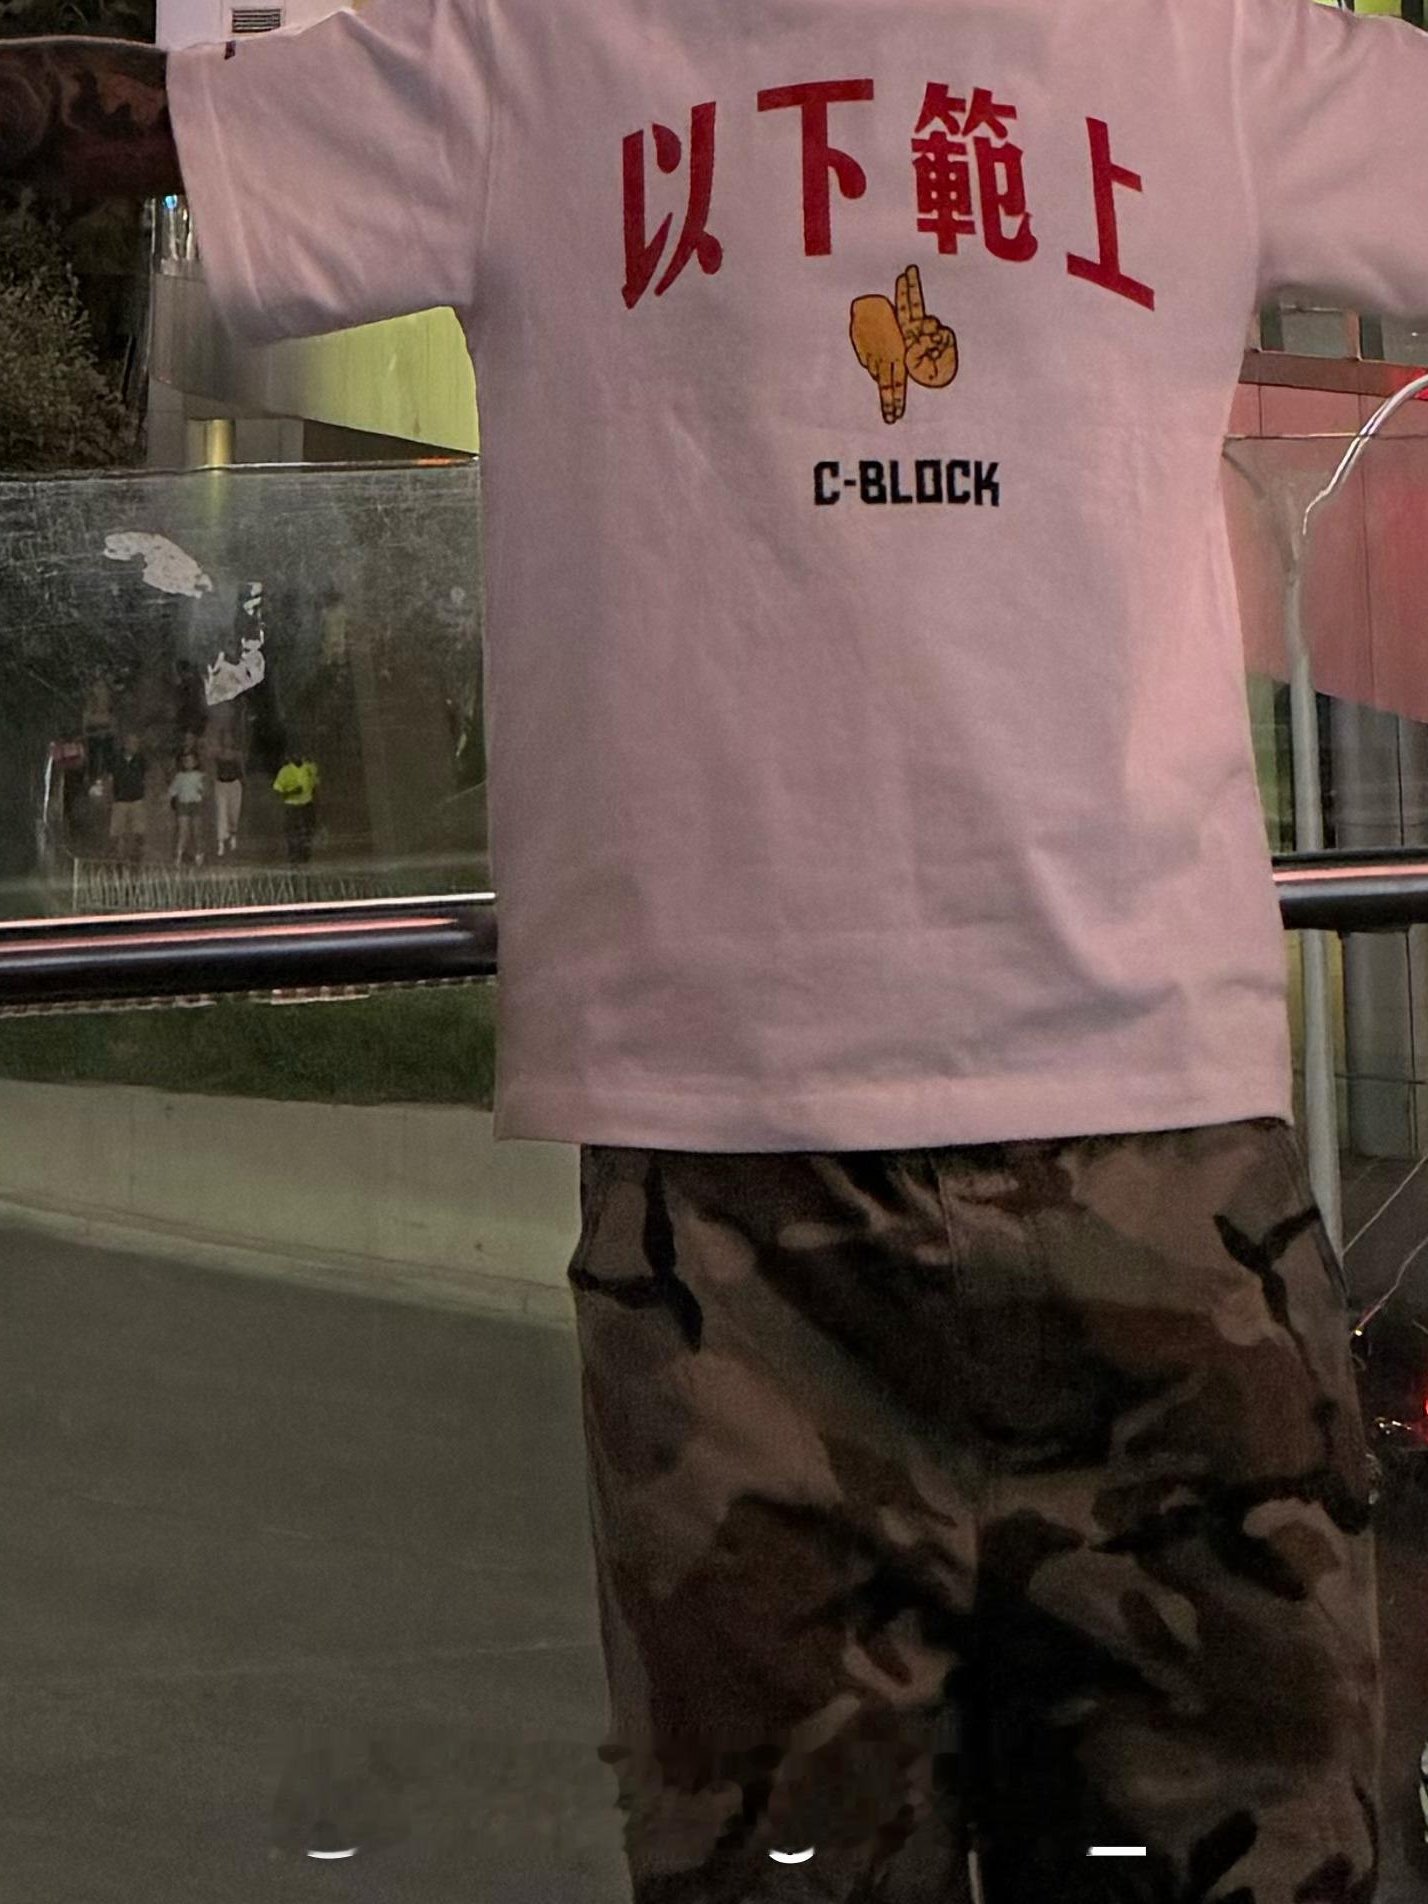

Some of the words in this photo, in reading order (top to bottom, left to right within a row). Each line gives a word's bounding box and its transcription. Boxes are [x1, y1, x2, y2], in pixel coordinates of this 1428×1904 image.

[622, 78, 1155, 310] 以下範上
[814, 459, 1001, 507] C-BLOCK
